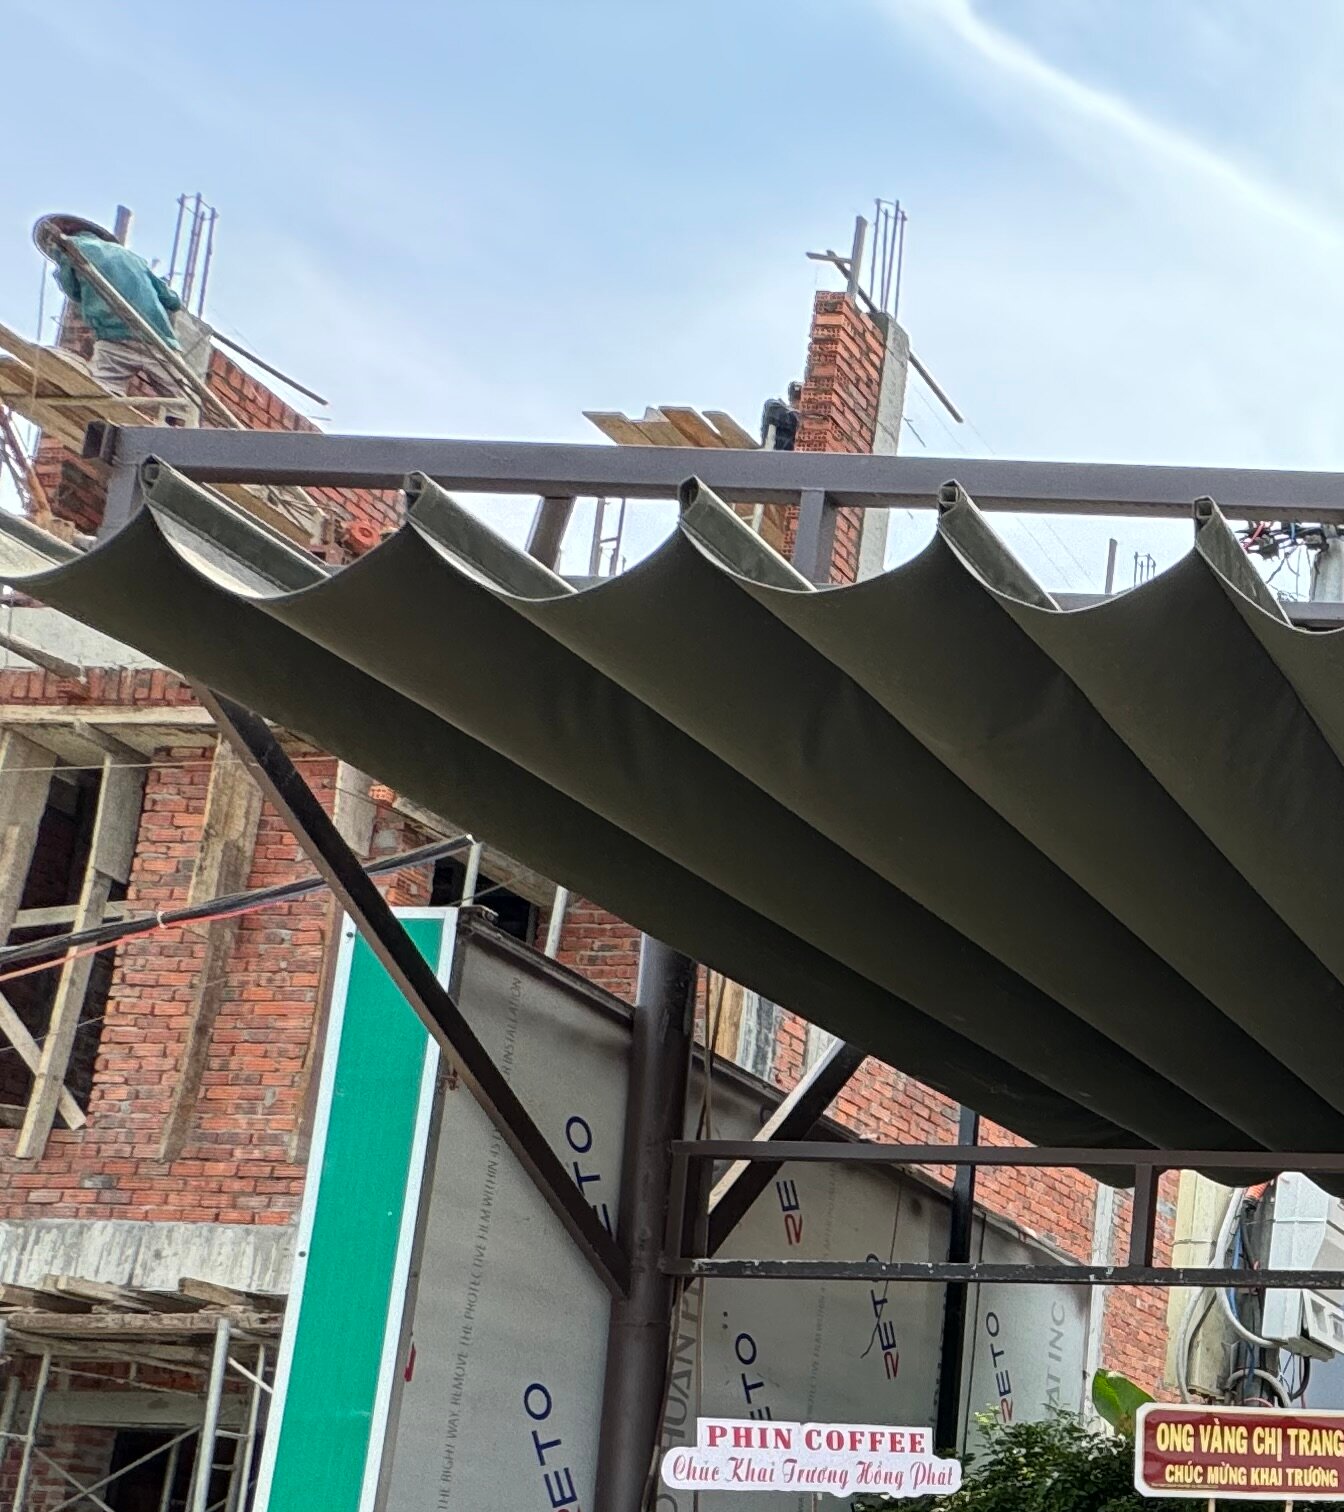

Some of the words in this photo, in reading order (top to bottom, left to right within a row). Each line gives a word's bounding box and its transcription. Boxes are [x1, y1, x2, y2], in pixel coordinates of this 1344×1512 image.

[707, 1425, 792, 1449] PHIN
[805, 1429, 925, 1453] COFFEE
[1156, 1423, 1194, 1452] ONG
[1200, 1418, 1248, 1454] VÀNG
[1253, 1427, 1282, 1461] CHỊ
[1287, 1428, 1344, 1457] TRANG
[726, 1456, 776, 1483] Khai
[855, 1460, 904, 1490] Hồng
[910, 1461, 954, 1490] Phát
[1165, 1460, 1203, 1483] CHÚC
[1207, 1462, 1247, 1485] MỪNG
[1251, 1468, 1282, 1486] KHAI
